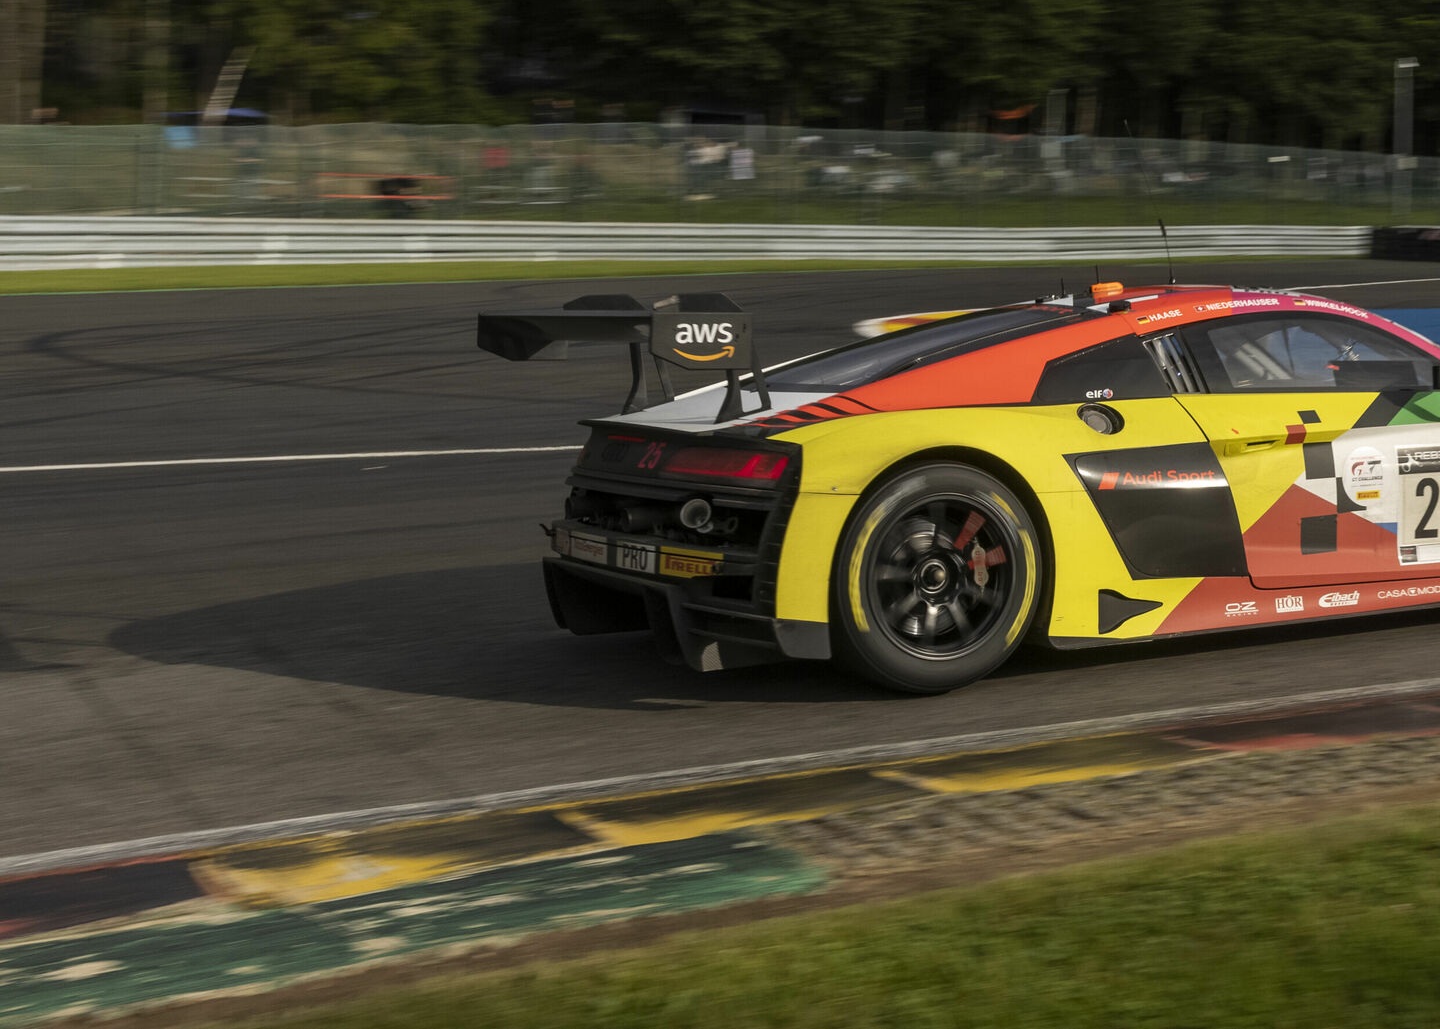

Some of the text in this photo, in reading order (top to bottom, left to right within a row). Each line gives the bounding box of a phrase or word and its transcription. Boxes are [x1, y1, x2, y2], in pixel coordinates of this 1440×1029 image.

[1206, 298, 1280, 311] NIEDERHAUSER
[1149, 309, 1182, 322] HAASE
[675, 323, 733, 344] aws
[1086, 390, 1103, 399] elf
[637, 442, 667, 469] 25
[1122, 471, 1163, 485] Audi
[621, 543, 649, 571] PRO
[664, 554, 719, 576] PIRELL
[1318, 591, 1360, 608] Eibach
